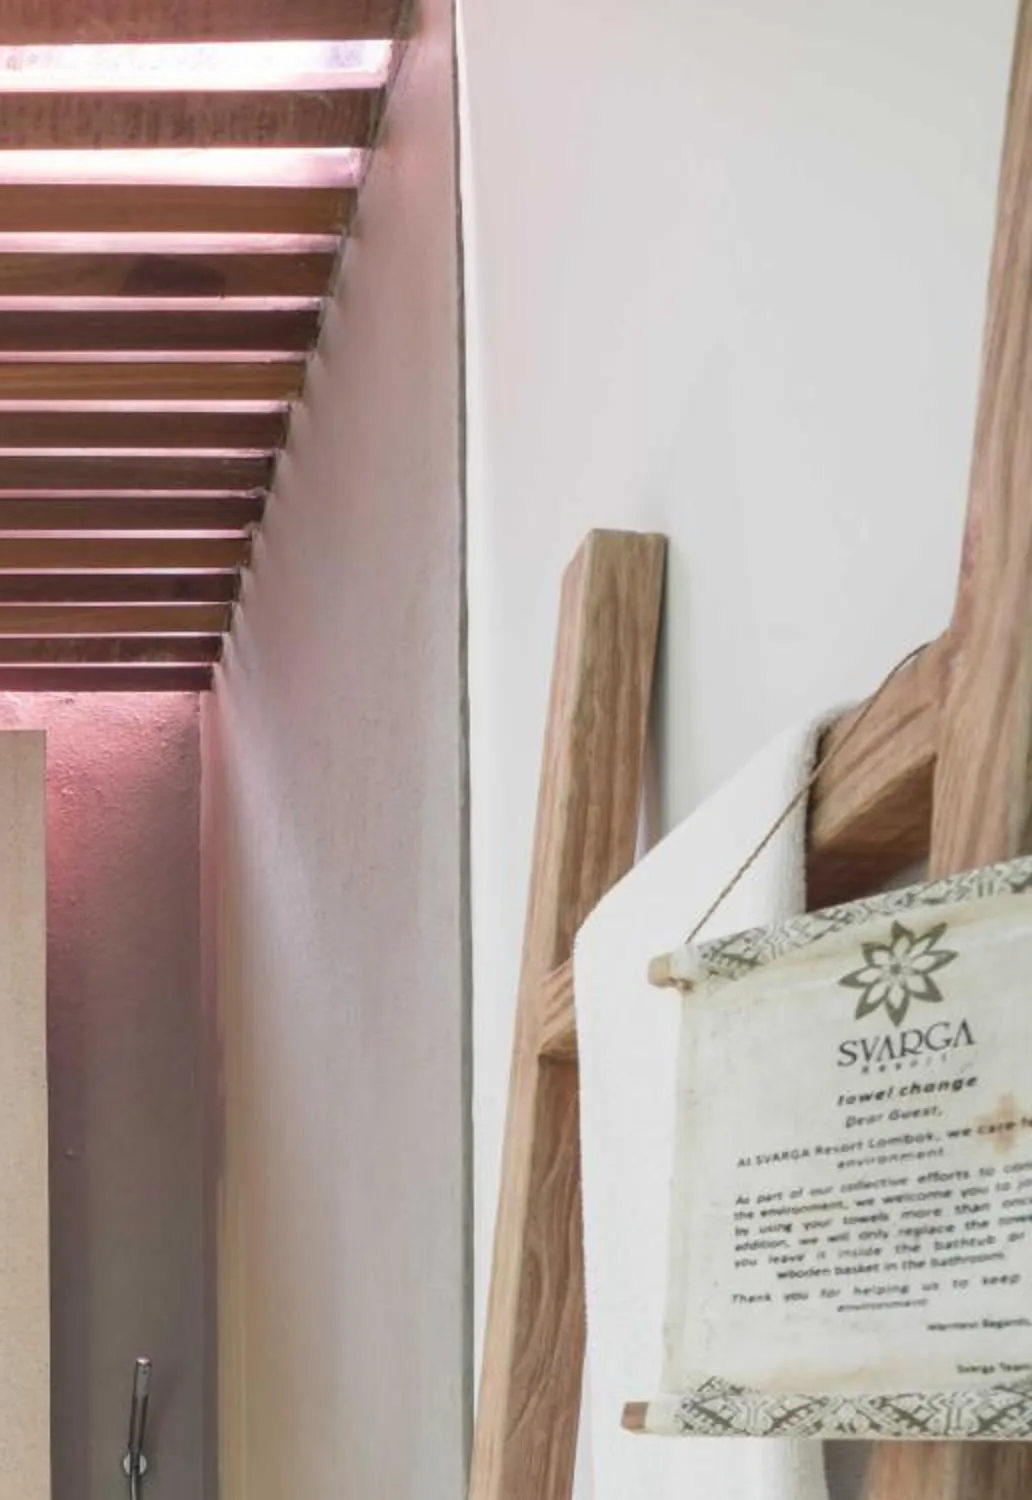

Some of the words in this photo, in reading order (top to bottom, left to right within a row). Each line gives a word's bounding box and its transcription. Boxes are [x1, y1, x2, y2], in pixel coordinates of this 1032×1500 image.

[836, 1017, 977, 1067] SVARGA
[898, 1076, 979, 1097] change
[845, 1113, 885, 1129] Dear
[887, 1105, 943, 1122] Guest,
[754, 1148, 811, 1165] SVARGA
[814, 1140, 864, 1155] Resort
[947, 1127, 972, 1138] we
[976, 1120, 1016, 1135] care
[734, 1210, 754, 1221] the
[854, 1197, 875, 1208] we
[881, 1188, 952, 1204] welcome
[959, 1186, 989, 1200] you
[994, 1180, 1012, 1192] to
[756, 1190, 783, 1204] part
[789, 1187, 804, 1199] of
[809, 1185, 834, 1197] our
[839, 1176, 908, 1194] collective
[917, 1169, 970, 1185] efforts
[978, 1167, 996, 1178] to
[758, 1222, 793, 1234] using
[802, 1218, 833, 1231] your
[842, 1212, 889, 1226] towels
[900, 1208, 943, 1219] more
[953, 1201, 991, 1215] than
[798, 1236, 819, 1247] we
[826, 1231, 850, 1243] will
[857, 1228, 889, 1242] only
[897, 1223, 956, 1239] replace
[963, 1218, 990, 1231] the
[734, 1257, 758, 1270] you
[768, 1252, 806, 1265] leave
[815, 1249, 827, 1261] it
[837, 1246, 883, 1260] inside
[894, 1242, 922, 1254] the
[933, 1234, 997, 1252] bathtub
[833, 1262, 880, 1277] basket
[883, 1260, 899, 1272] in
[900, 1258, 927, 1272] the
[731, 1292, 772, 1305] Thank
[782, 1290, 810, 1303] you
[819, 1286, 841, 1300] for
[852, 1283, 911, 1297] helping
[920, 1280, 941, 1292] us
[952, 1277, 970, 1290] to
[981, 1272, 1022, 1288] keep
